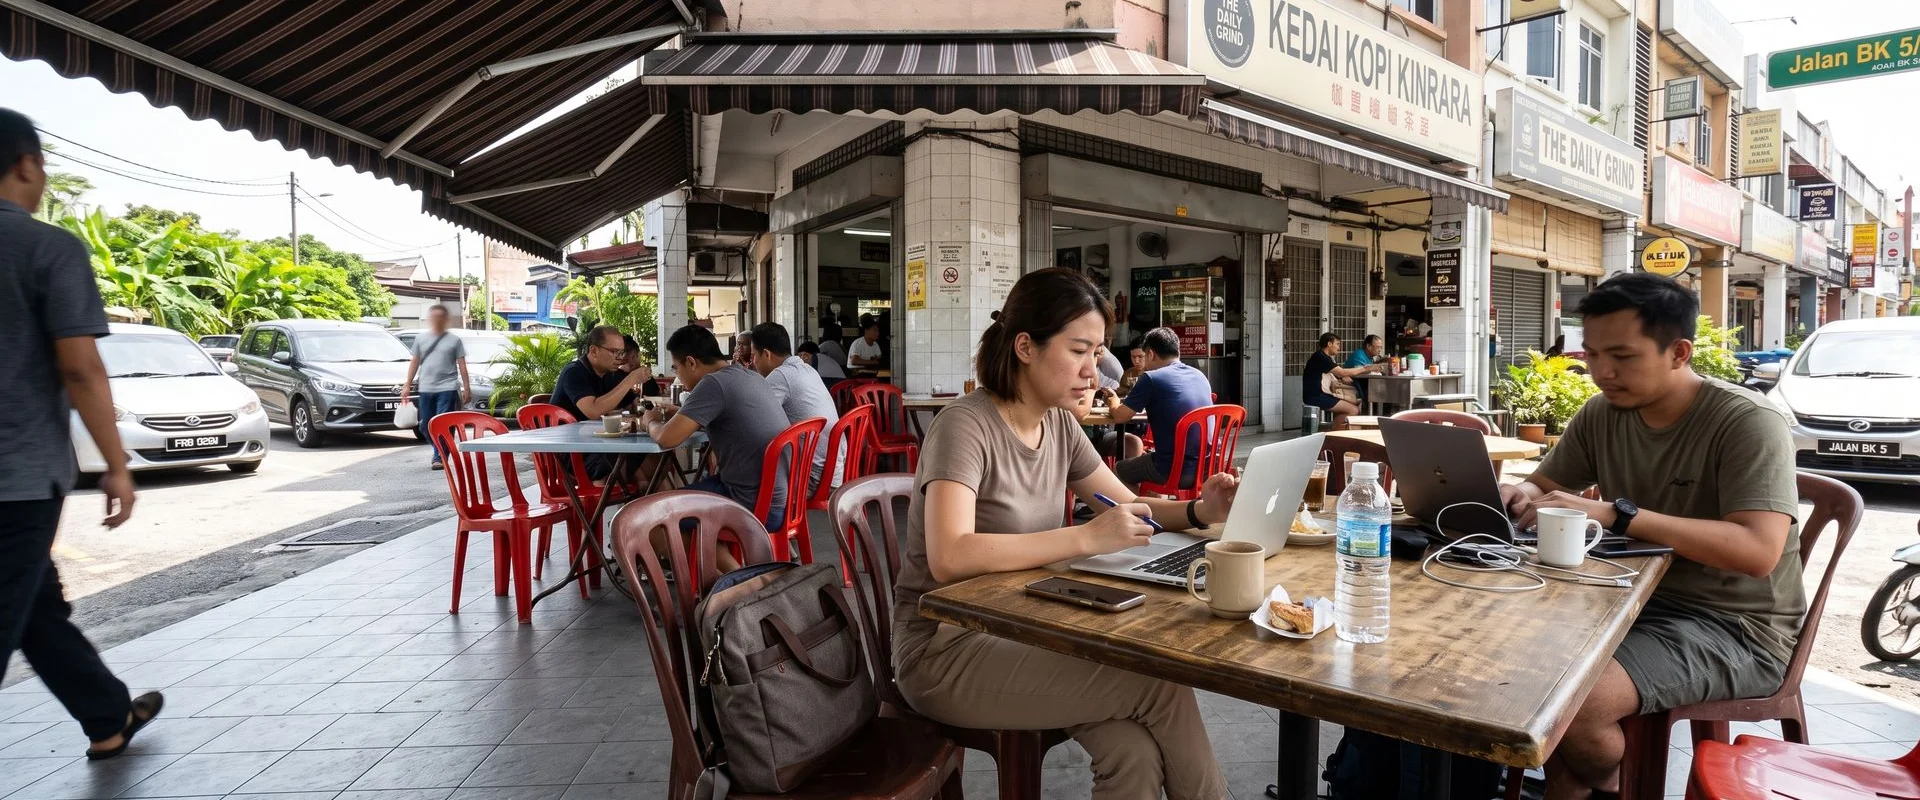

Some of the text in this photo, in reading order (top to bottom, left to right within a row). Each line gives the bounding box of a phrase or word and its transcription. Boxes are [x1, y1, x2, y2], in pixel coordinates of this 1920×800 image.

[1217, 7, 1243, 30] DAILY
[1215, 24, 1244, 46] GRIND
[1269, 0, 1339, 75] KEDAI
[1345, 33, 1392, 95] KOPI
[1398, 53, 1472, 127] KINRARA
[1788, 51, 1848, 74] Jalan
[1856, 39, 1891, 64] BK
[1897, 58, 1911, 67] BK
[1542, 124, 1567, 165] THE
[1570, 137, 1602, 178] DAILY
[1604, 152, 1635, 191] GRIND
[1828, 442, 1888, 454] JALAN BK 5
